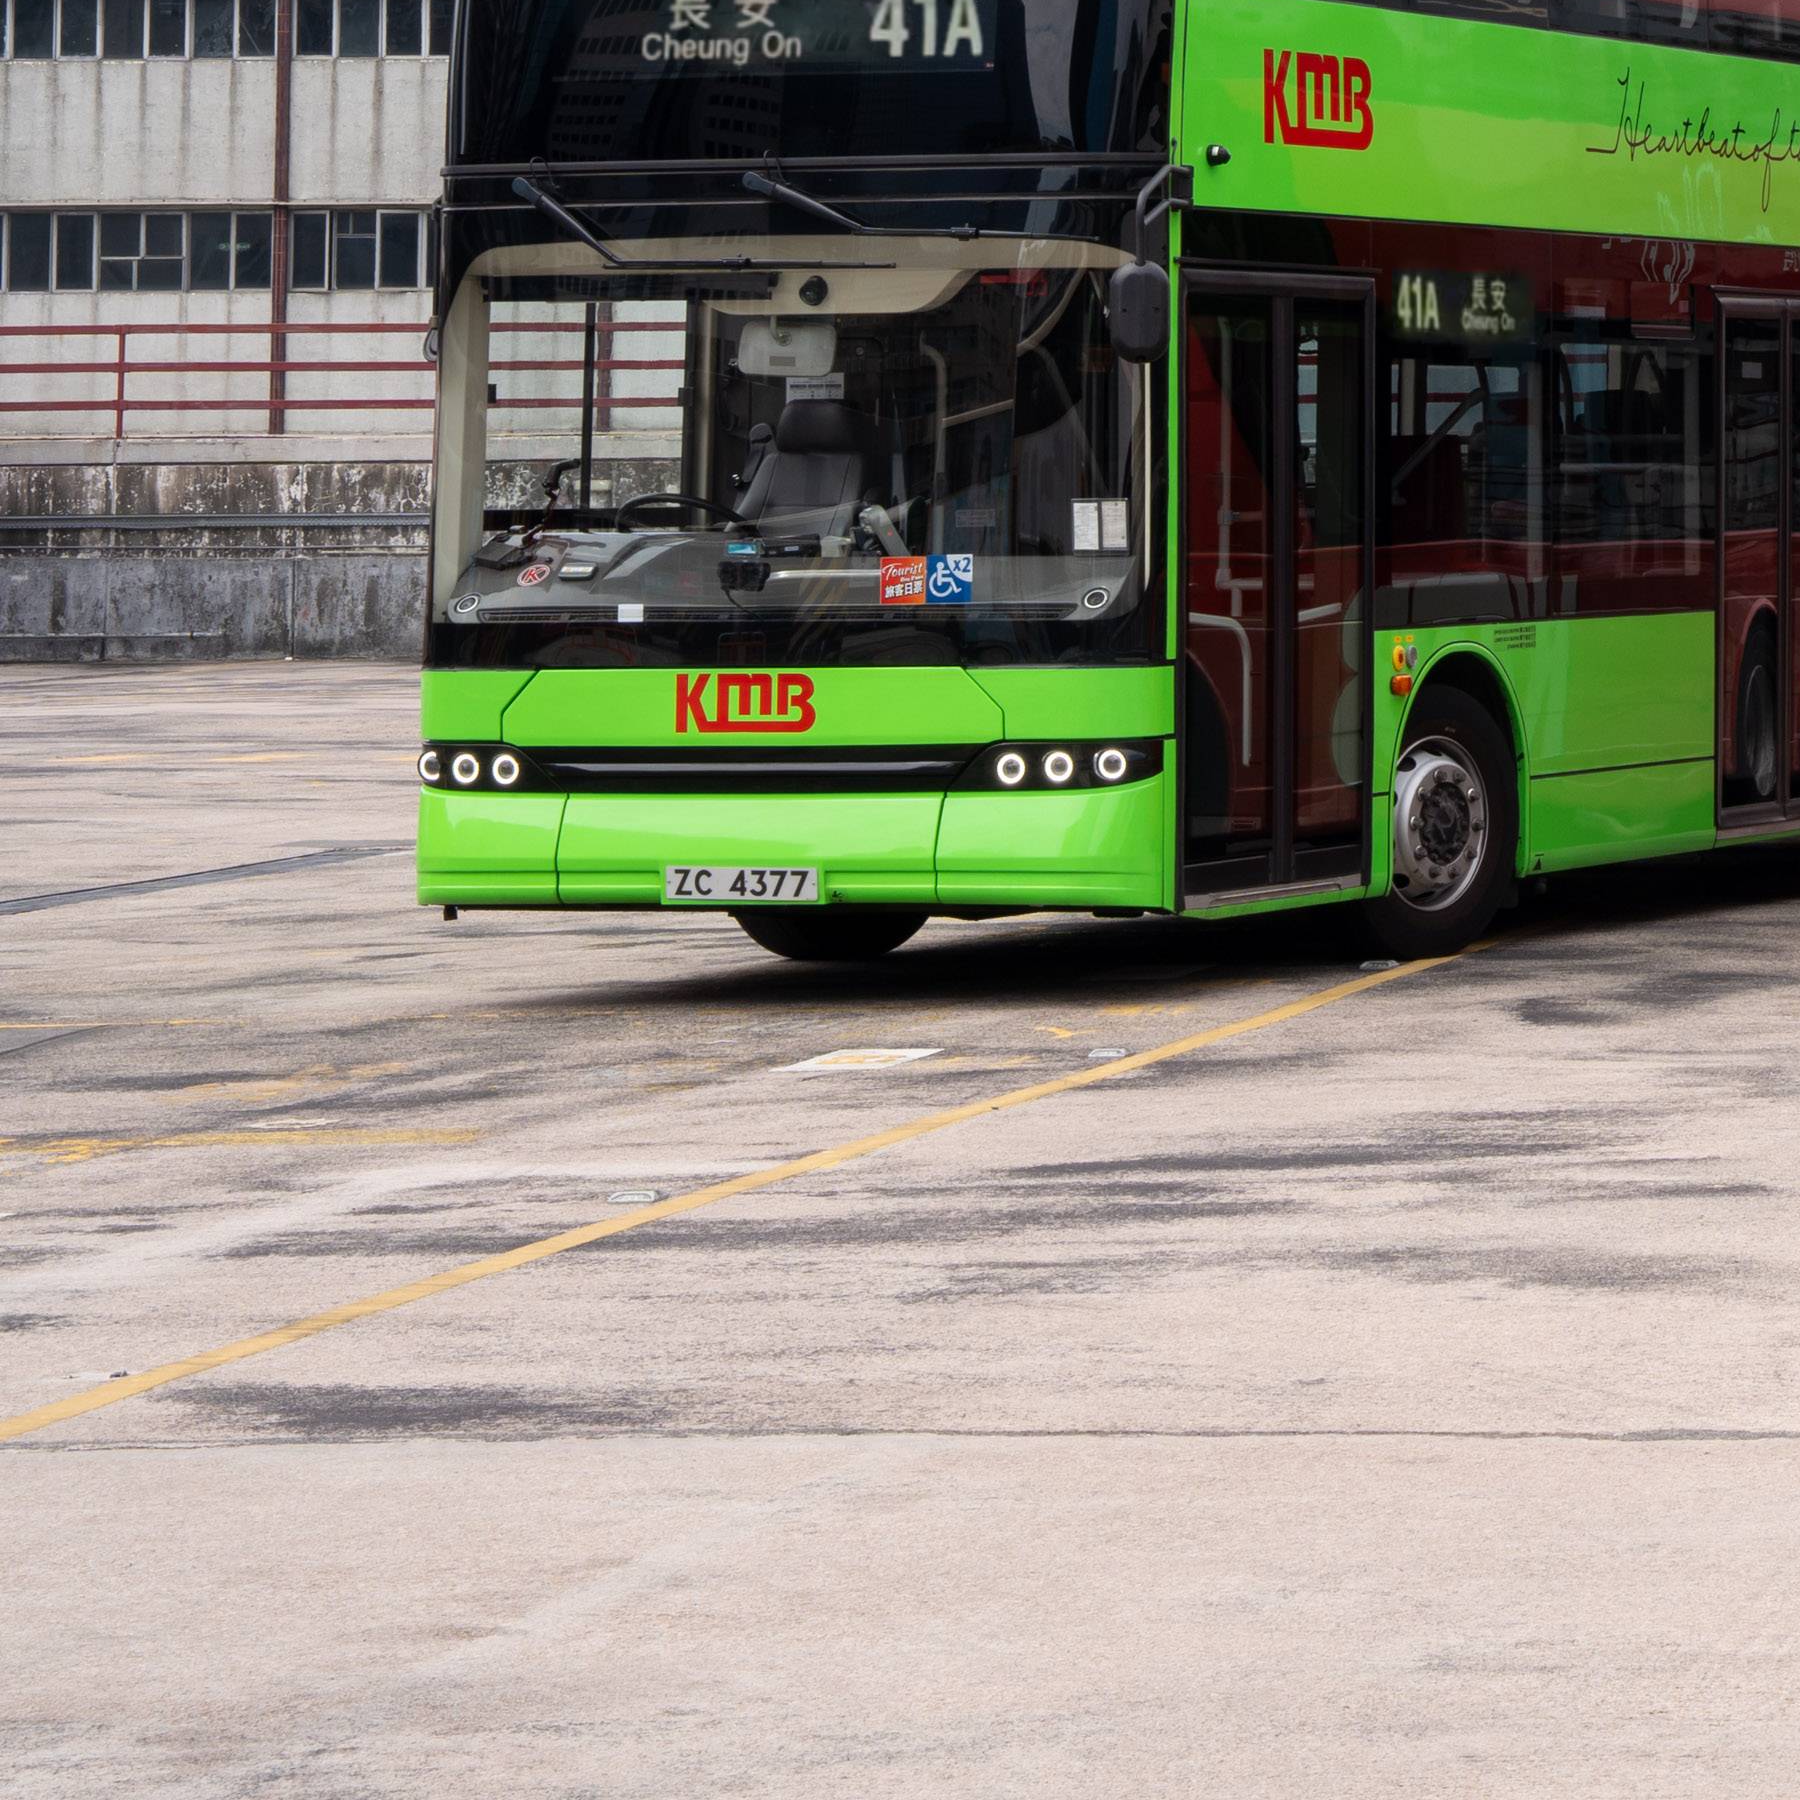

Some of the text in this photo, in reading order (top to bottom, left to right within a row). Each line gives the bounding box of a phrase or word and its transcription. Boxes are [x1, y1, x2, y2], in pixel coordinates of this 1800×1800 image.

[640, 30, 802, 66] Cheung On
[1602, 66, 1746, 162] Heartbeat
[1397, 274, 1441, 331] 41A
[881, 562, 923, 581] Tourist
[674, 868, 811, 898] ZC 4377
